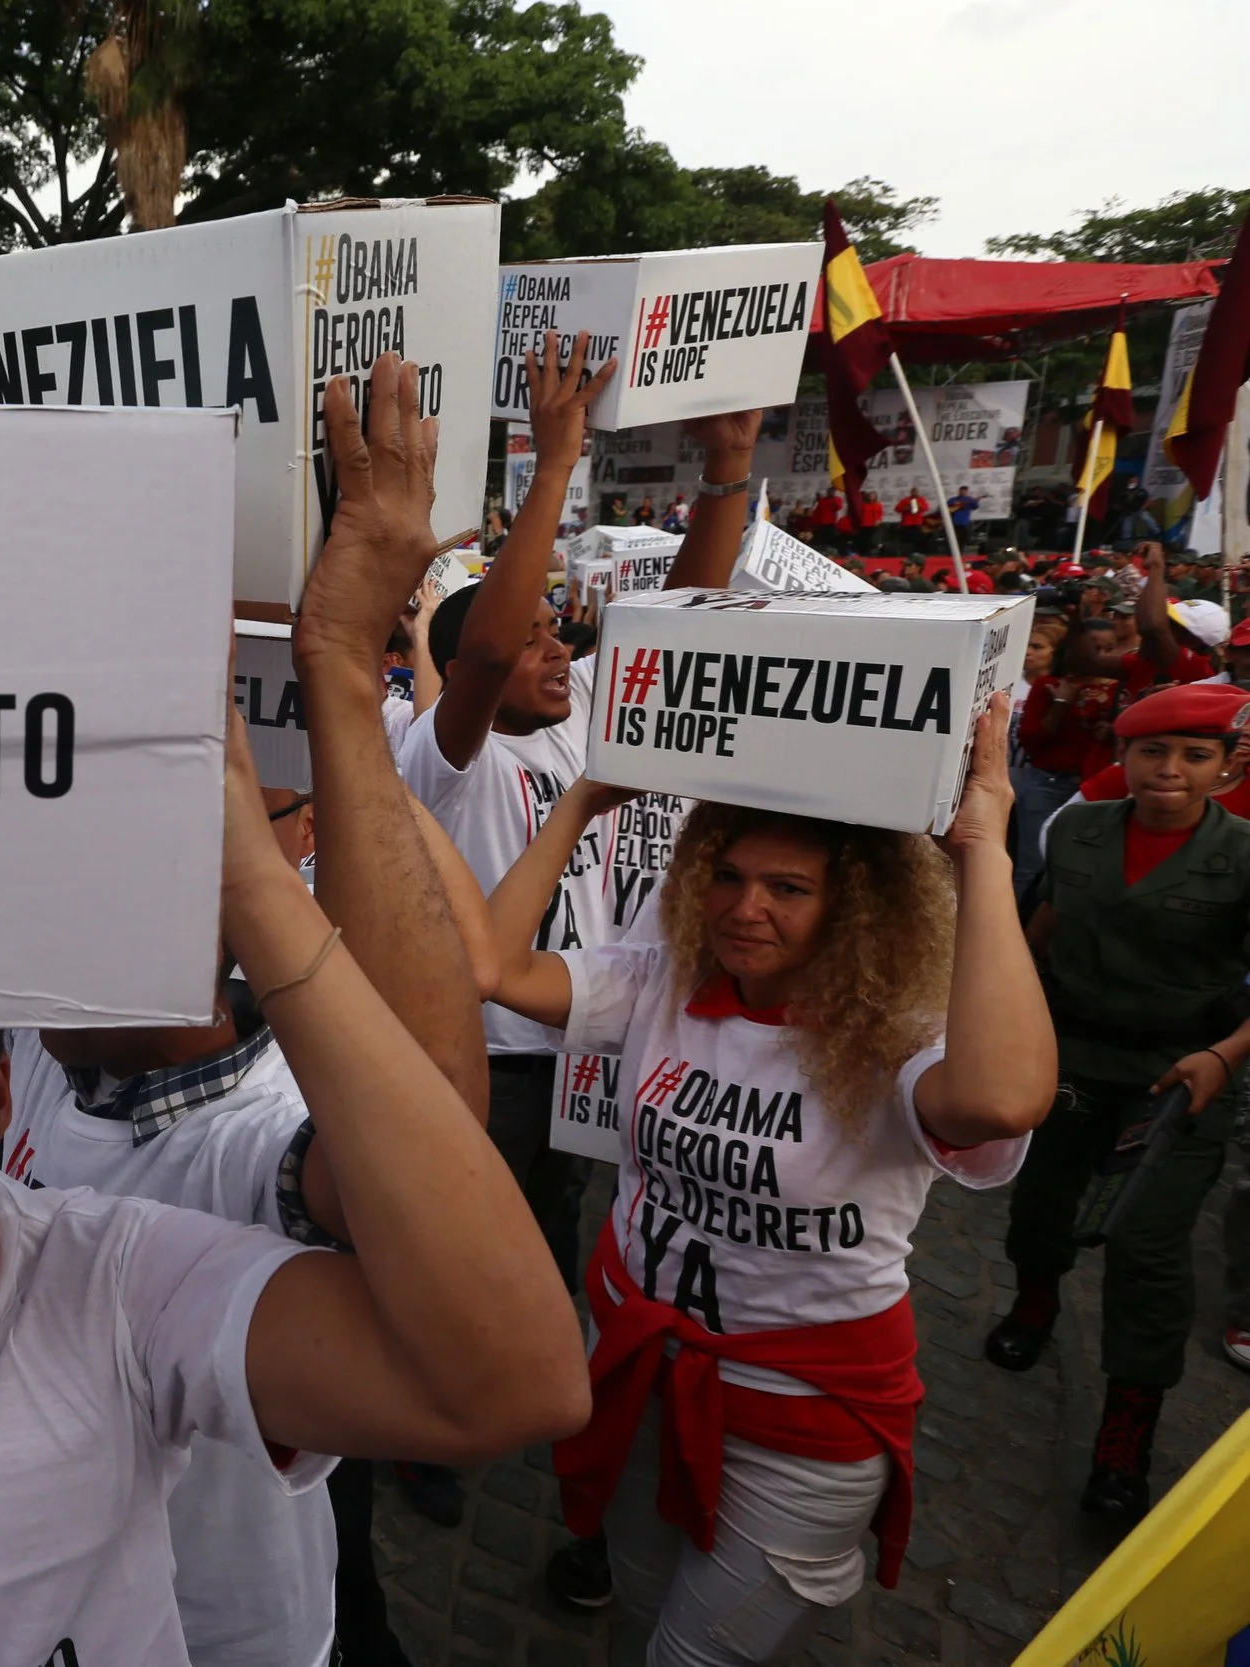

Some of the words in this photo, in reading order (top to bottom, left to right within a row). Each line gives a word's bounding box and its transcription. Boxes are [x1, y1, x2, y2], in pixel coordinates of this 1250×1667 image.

[315, 233, 418, 306] #OBAMA
[505, 274, 571, 301] #OBAMA
[313, 305, 406, 379] DEROGA
[501, 330, 529, 357] THE
[502, 302, 558, 330] REPEAL
[643, 281, 807, 349] #VENEZUELA
[637, 350, 658, 387] IS
[660, 344, 709, 384] HOPE
[932, 421, 989, 442] ORDER
[619, 579, 630, 592] IS
[633, 576, 660, 591] HOPE
[621, 648, 950, 735] #VENEZUELA
[616, 706, 646, 746] IS
[654, 710, 738, 757] HOPE
[568, 1093, 591, 1124] IS
[646, 1060, 802, 1143] #OBAMA
[638, 1104, 780, 1198] DEROGA
[640, 1155, 678, 1214] EL
[679, 1174, 865, 1253] DECRETO
[640, 1200, 726, 1336] YA
